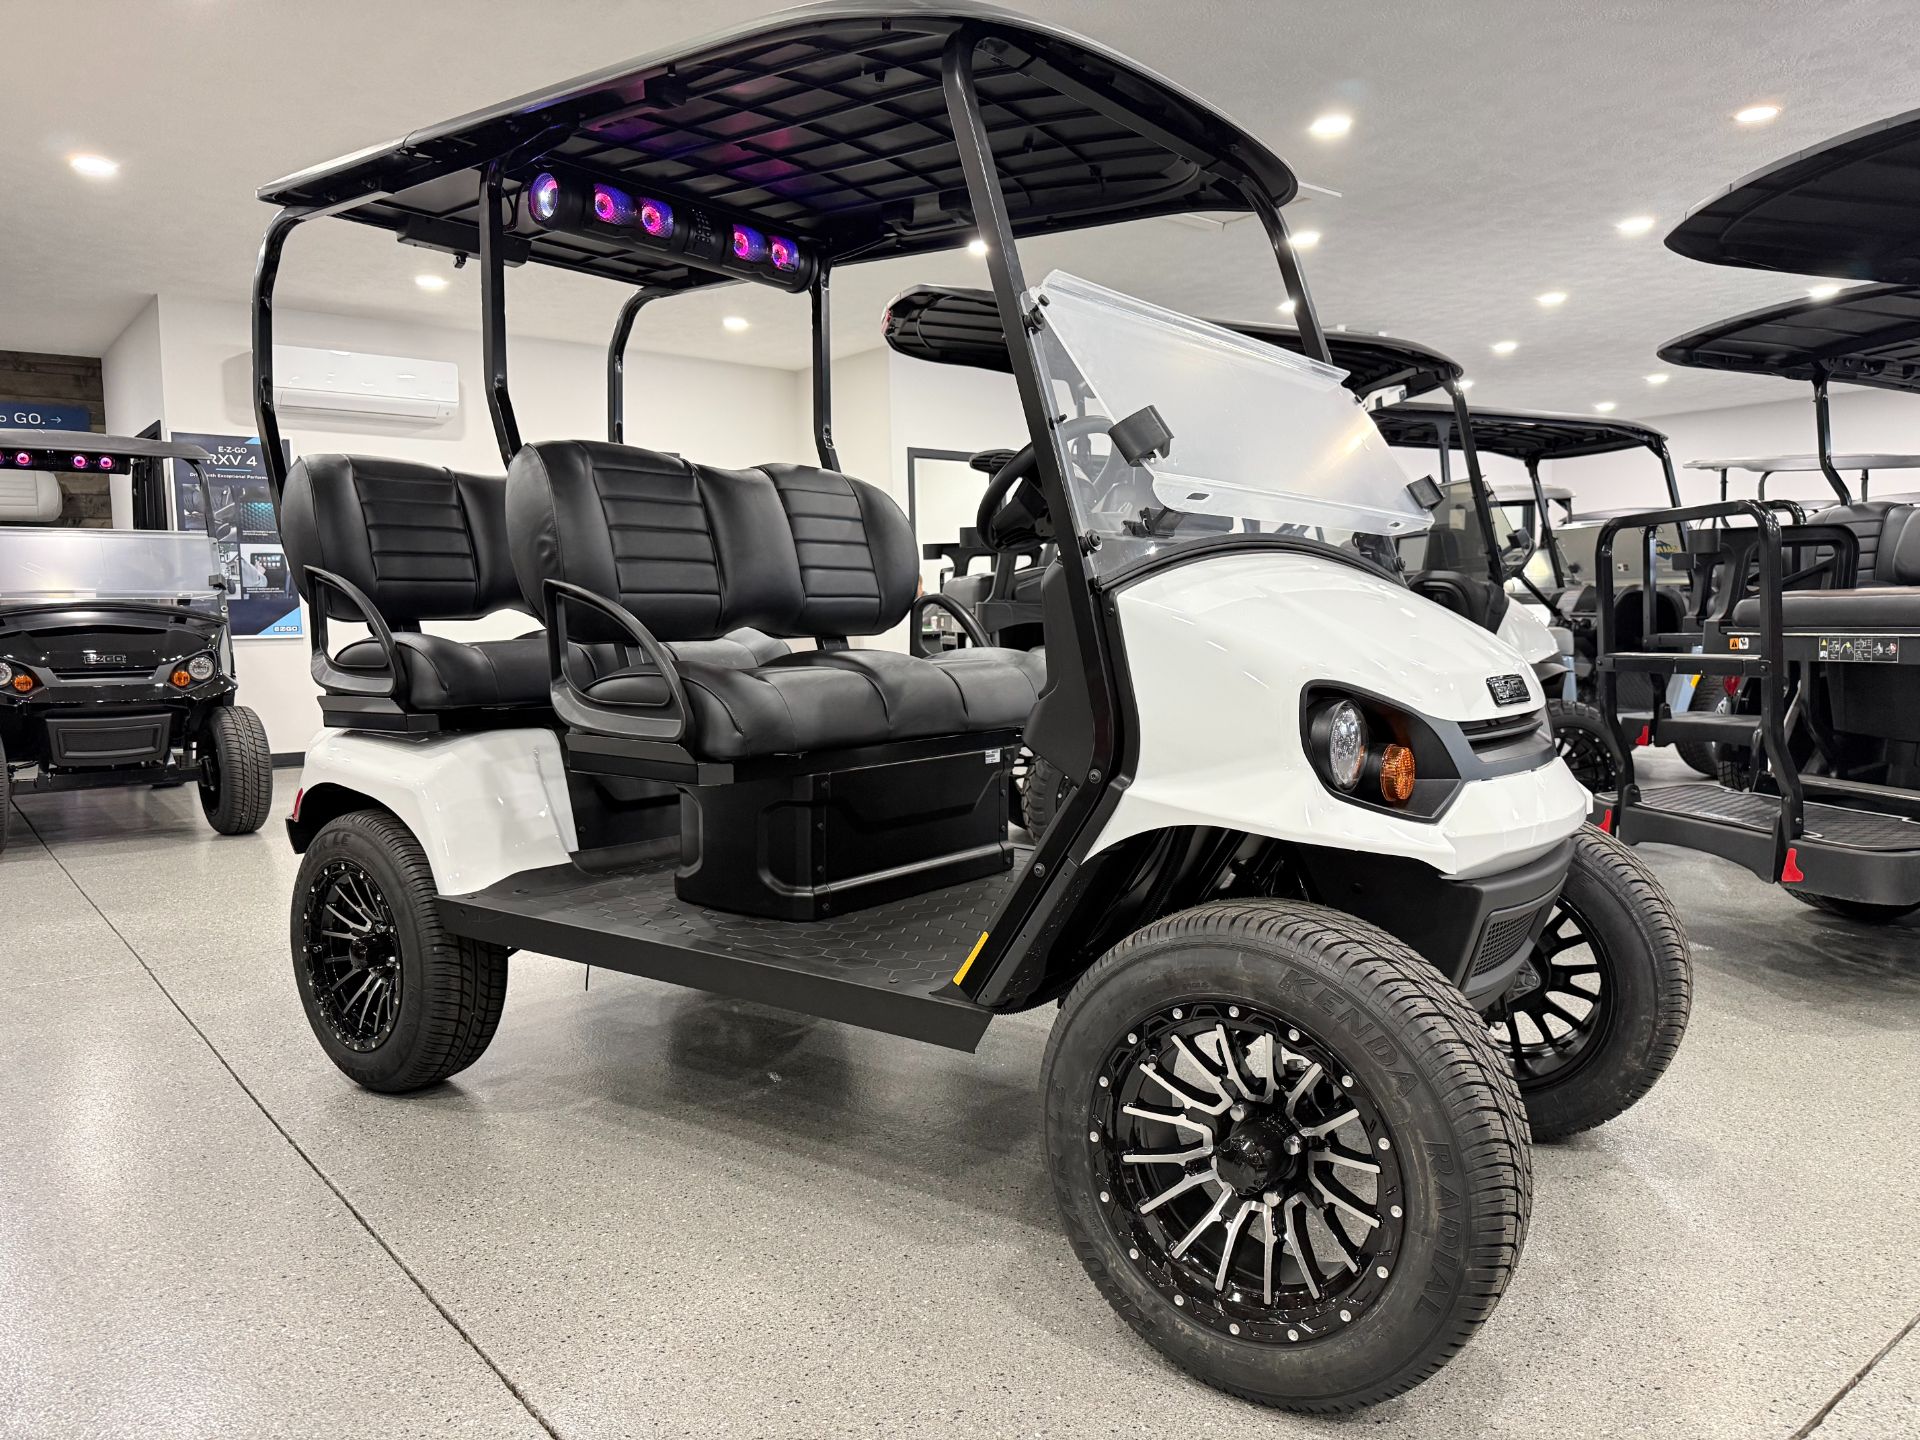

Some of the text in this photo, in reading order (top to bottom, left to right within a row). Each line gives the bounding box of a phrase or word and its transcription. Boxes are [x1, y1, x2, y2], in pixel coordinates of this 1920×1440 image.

[14, 412, 46, 425] GO.
[218, 446, 247, 454] E-Z-GO
[206, 454, 257, 466] RXV 4
[1278, 968, 1420, 1098] KENDA
[1413, 1139, 1464, 1316] RADIAL
